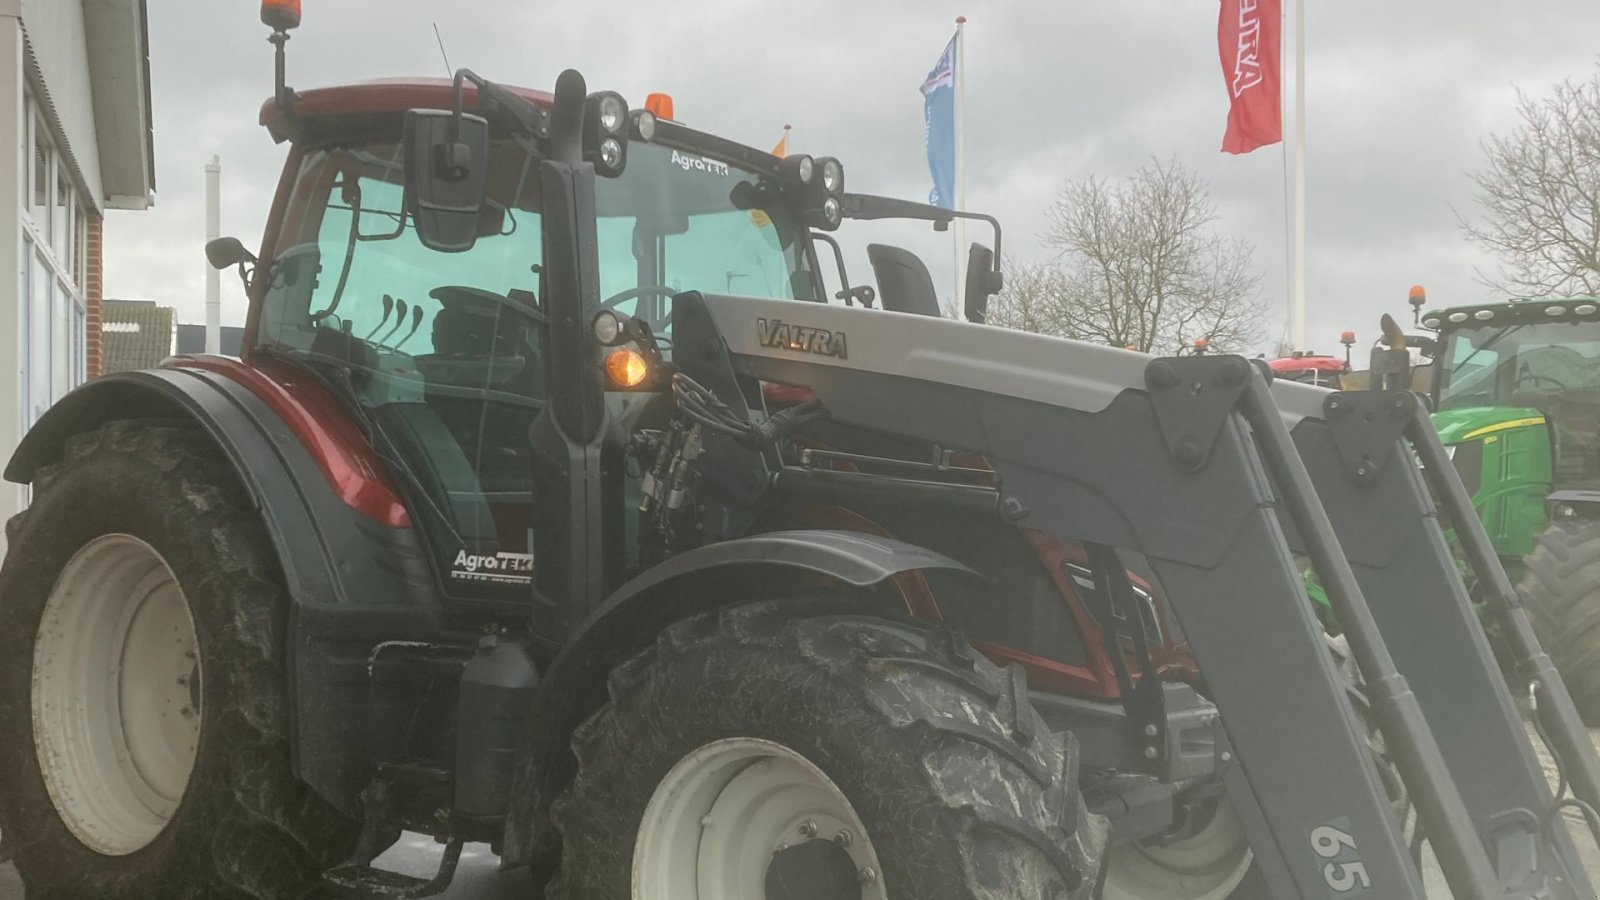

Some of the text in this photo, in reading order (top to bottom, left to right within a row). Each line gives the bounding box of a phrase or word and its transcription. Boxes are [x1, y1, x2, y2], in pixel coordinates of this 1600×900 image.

[757, 317, 848, 360] VALTRA
[454, 549, 534, 572] AgroTEK
[1310, 825, 1371, 892] 65
